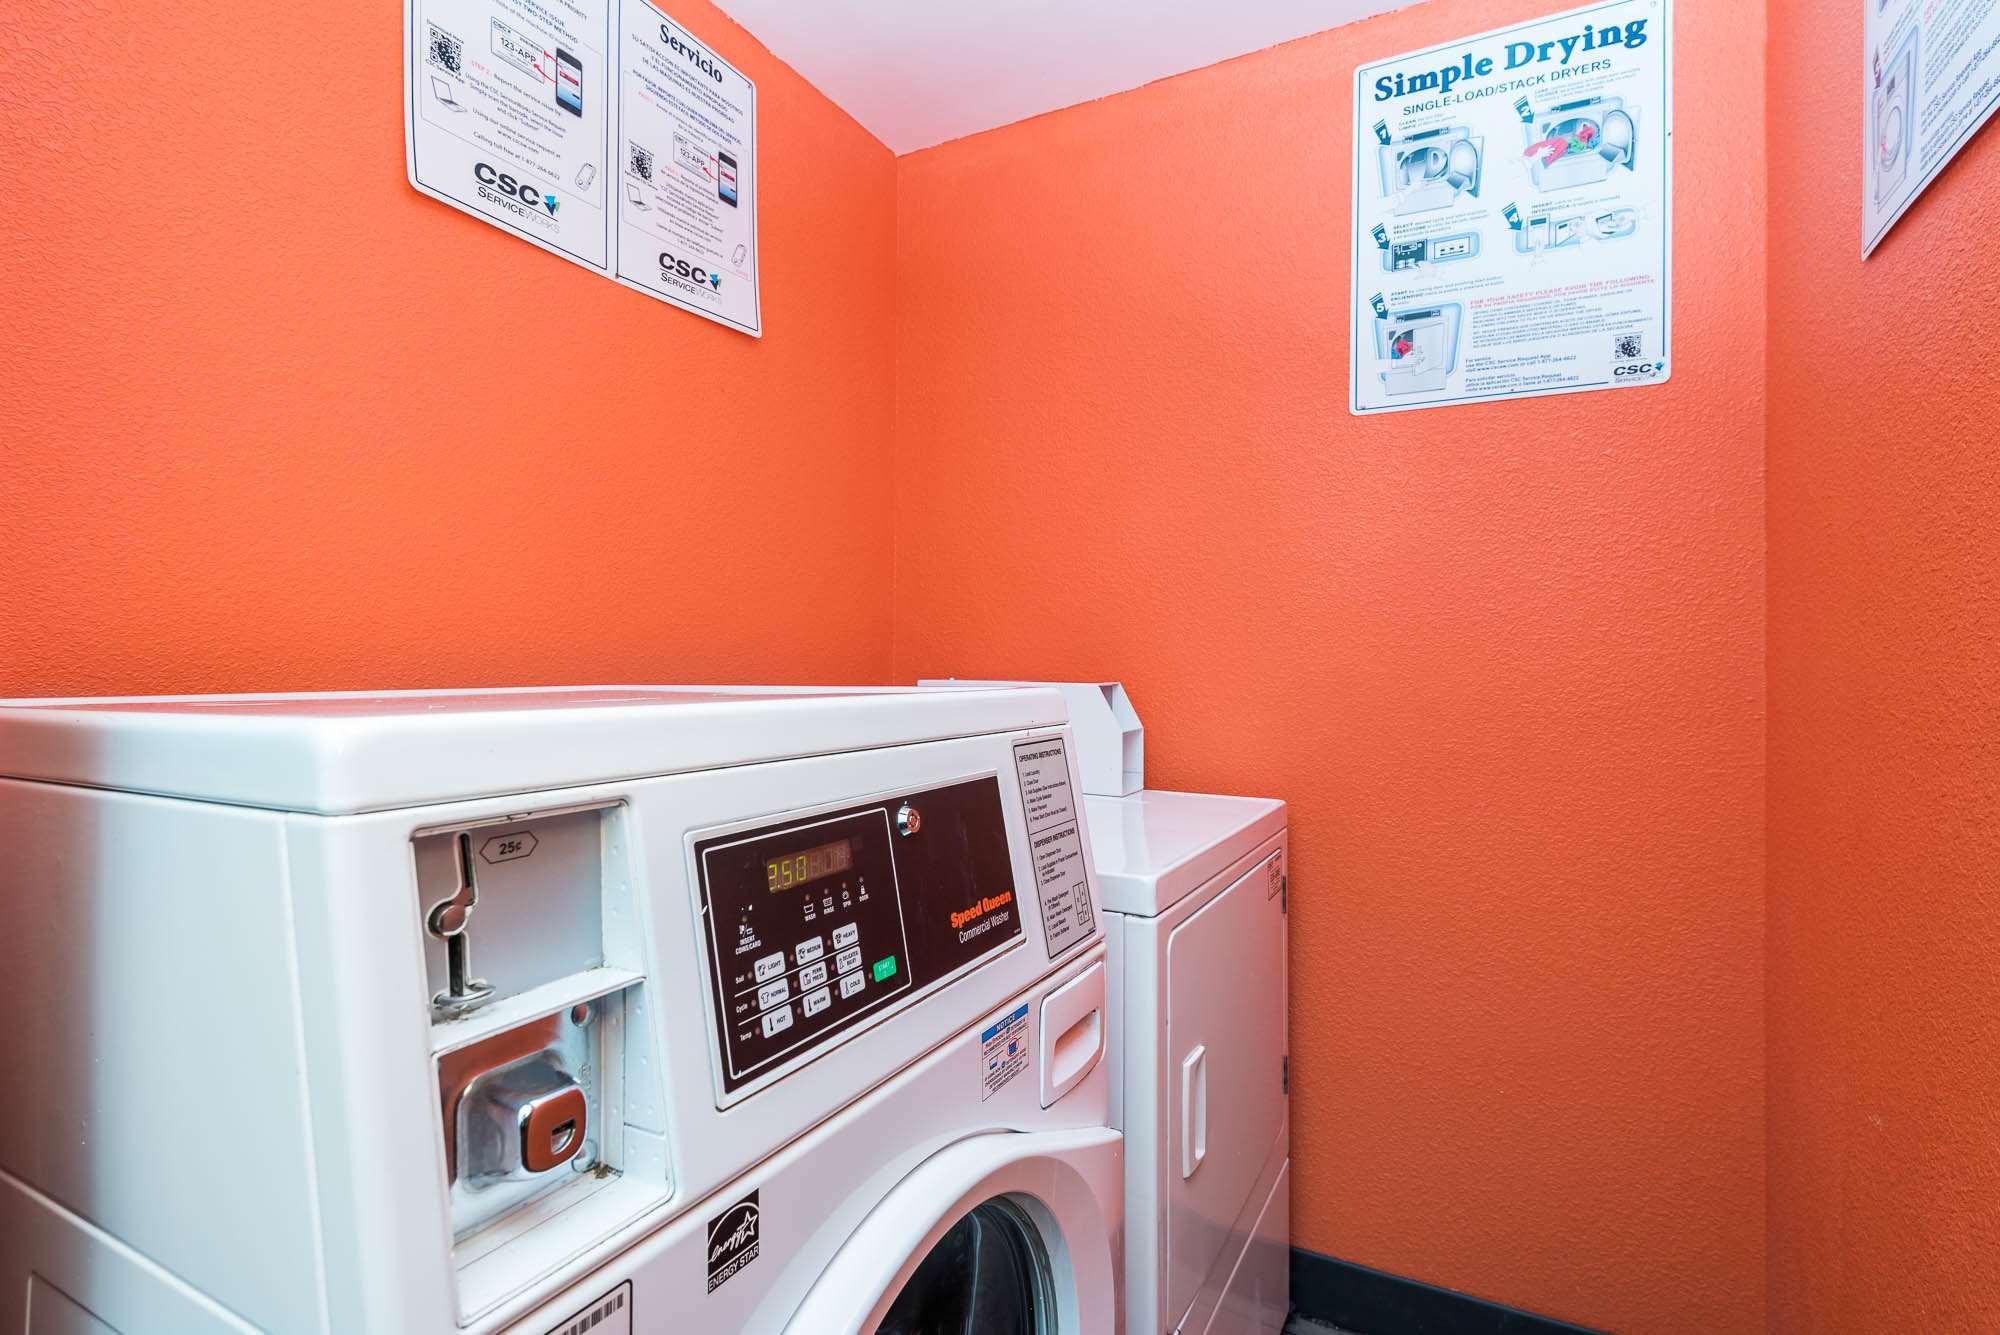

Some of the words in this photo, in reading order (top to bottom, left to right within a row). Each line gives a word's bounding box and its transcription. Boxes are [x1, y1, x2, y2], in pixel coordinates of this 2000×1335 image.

[501, 36, 536, 65] 123-APP
[660, 24, 723, 83] Servicio
[1374, 53, 1493, 102] Simple
[1504, 19, 1649, 70] Drying
[1402, 74, 1546, 116] SINGLE-LOAD/STACK
[1551, 59, 1612, 82] DRYERS
[473, 130, 492, 145] Calling
[474, 162, 540, 206] CSC
[659, 252, 706, 284] CSC
[1613, 364, 1652, 375] CSC
[499, 840, 522, 855] 25¢
[951, 901, 982, 928] Speed
[983, 891, 1011, 912] Queen
[959, 919, 991, 943] Commercial
[991, 911, 1009, 927] Washer
[767, 959, 781, 971] LIGHT
[806, 943, 821, 954] MEDIUM
[842, 929, 855, 939] HEAVY
[877, 960, 889, 972] START
[770, 985, 786, 998] NORMAL
[812, 972, 824, 982] PRESS
[740, 1030, 752, 1042] Temp
[776, 1014, 786, 1024] HOT
[813, 995, 826, 1006] WARM
[849, 978, 860, 989] COLD
[996, 1014, 1016, 1031] NOTICE
[708, 1260, 739, 1291] ENERGY
[740, 1245, 759, 1266] STAR
